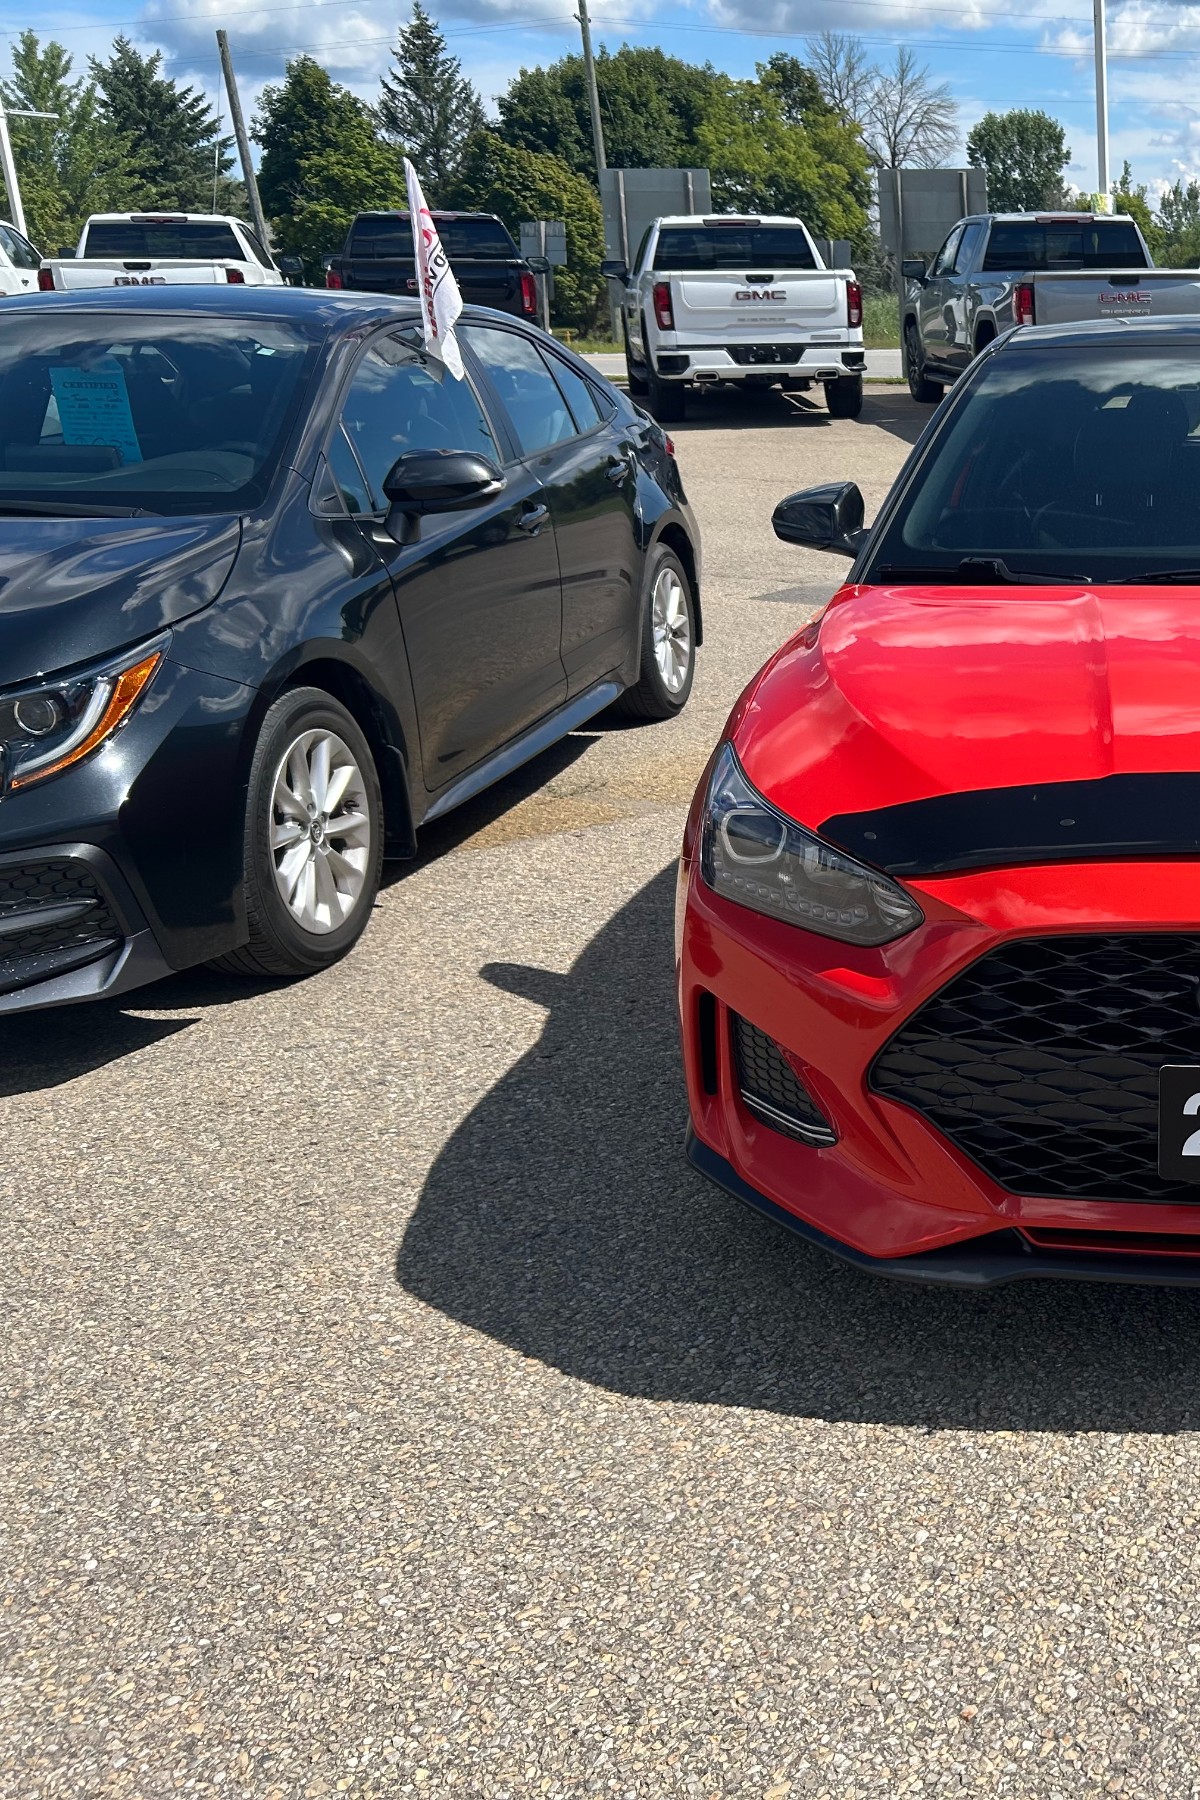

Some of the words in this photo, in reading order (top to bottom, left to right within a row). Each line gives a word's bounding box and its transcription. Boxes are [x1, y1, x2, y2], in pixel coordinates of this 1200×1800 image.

[735, 290, 787, 300] GMC
[1099, 290, 1152, 304] GMC
[62, 381, 118, 389] CERTIFIED
